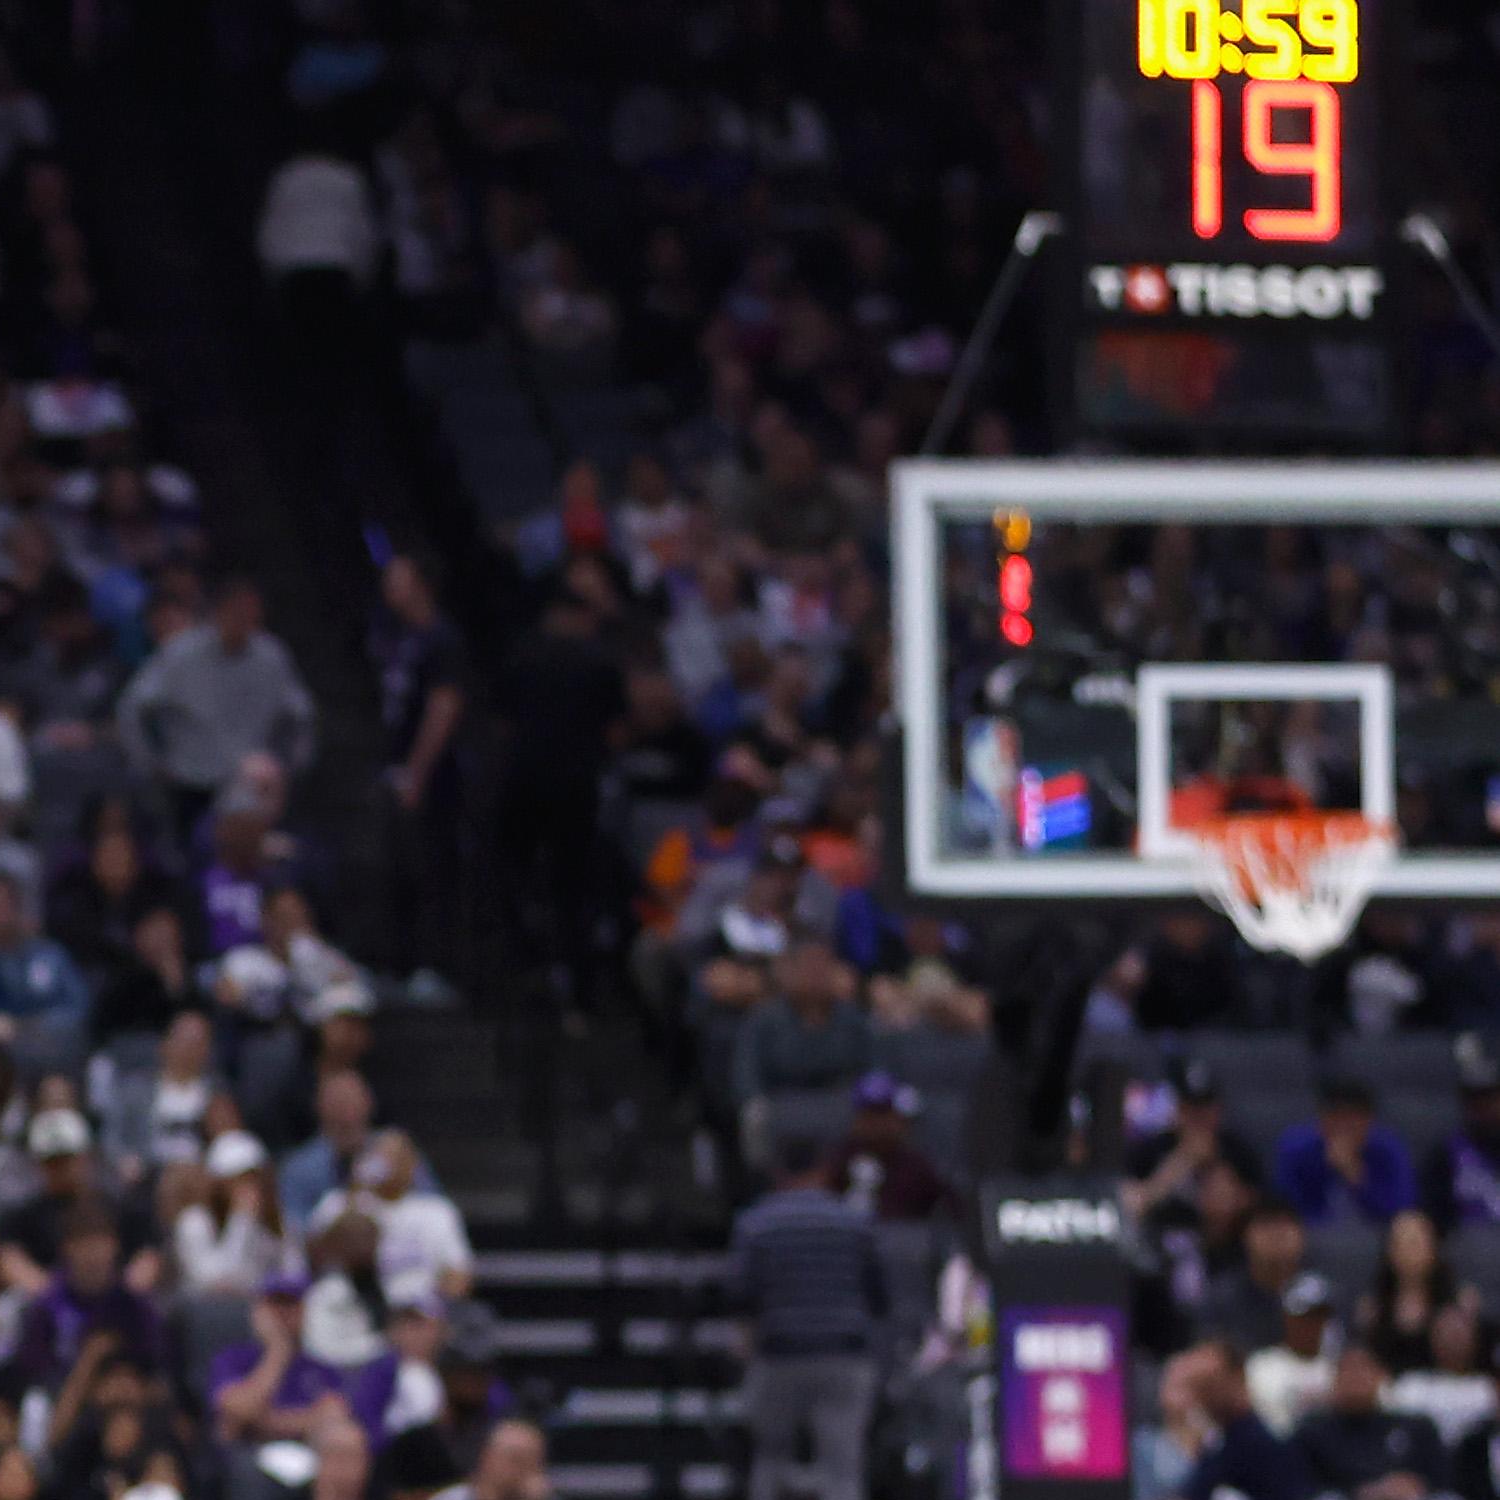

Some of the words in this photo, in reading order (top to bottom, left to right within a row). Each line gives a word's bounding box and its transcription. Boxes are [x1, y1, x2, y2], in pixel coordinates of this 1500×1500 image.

[1138, 0, 1359, 82] 10:59
[1191, 78, 1342, 242] 19
[1166, 262, 1384, 320] TISSOT
